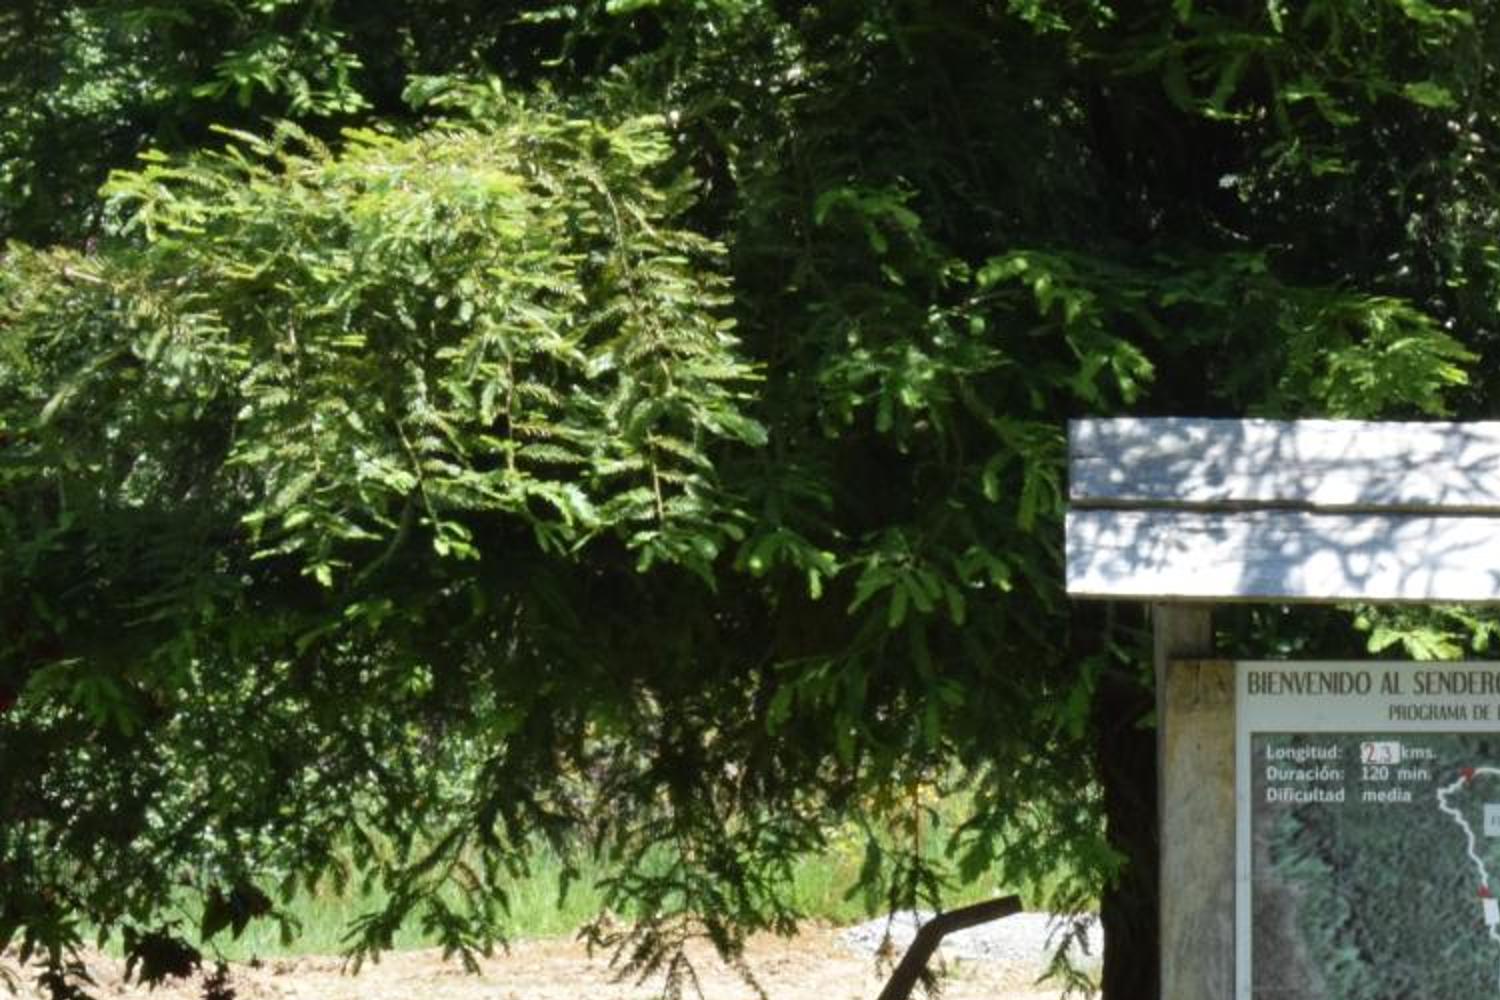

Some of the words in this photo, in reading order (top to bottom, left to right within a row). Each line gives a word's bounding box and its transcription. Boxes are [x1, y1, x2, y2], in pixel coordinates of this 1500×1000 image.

[1247, 671, 1372, 696] BIENVENIDO
[1380, 671, 1403, 696] AL
[1389, 703, 1467, 721] PROGRAMA
[1473, 703, 1489, 721] DE
[1266, 743, 1343, 762] Longitud:
[1401, 744, 1437, 760] kms.
[1266, 766, 1345, 781] Duración:
[1362, 766, 1389, 781] 120
[1397, 767, 1432, 781] min.
[1266, 787, 1345, 802] Dificultad
[1362, 787, 1412, 802] media
